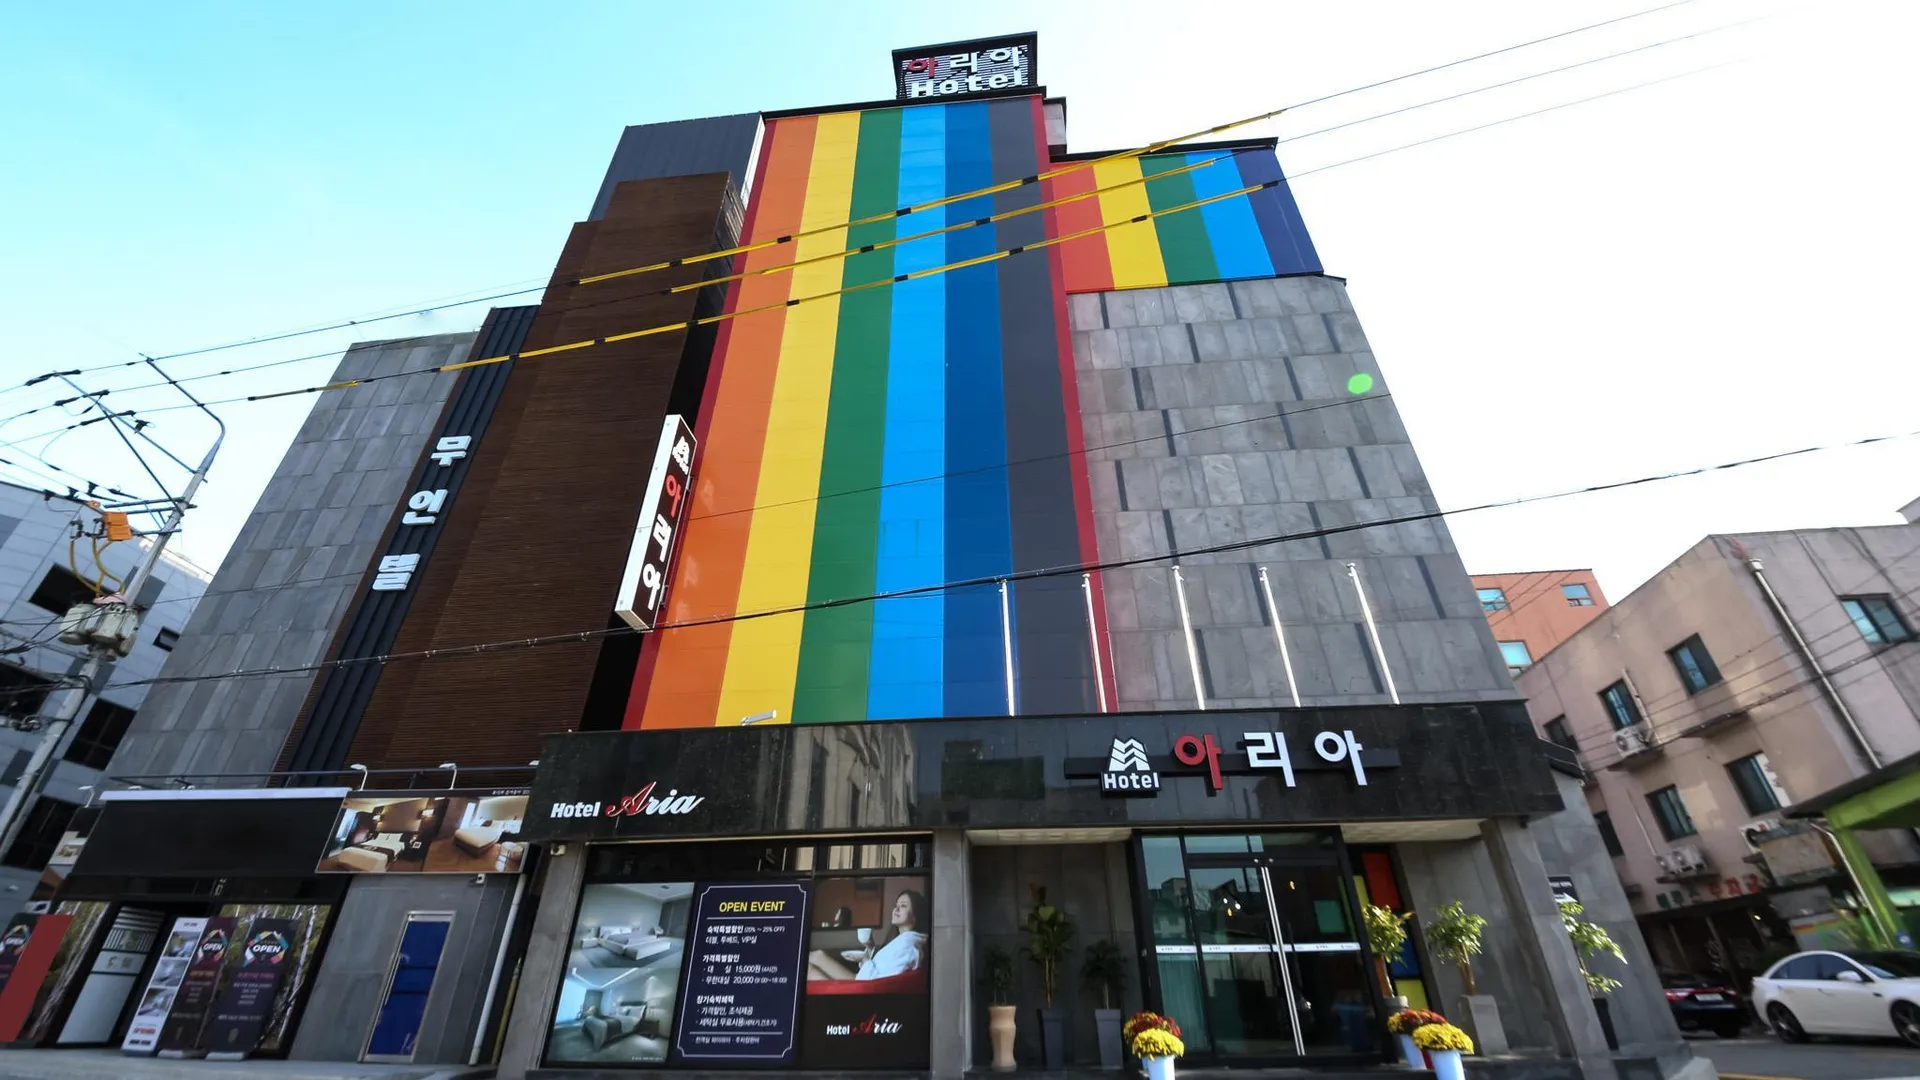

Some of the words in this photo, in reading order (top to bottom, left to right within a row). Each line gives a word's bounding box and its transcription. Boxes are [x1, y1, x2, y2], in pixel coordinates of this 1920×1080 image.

[907, 46, 1023, 78] 아리아
[911, 69, 1024, 98] Hotel
[372, 435, 472, 590] 무인텔
[642, 474, 682, 611] 아리아
[1174, 730, 1368, 790] 아리아
[1103, 771, 1160, 790] Hotel
[550, 801, 601, 818] Hotel
[605, 781, 705, 817] Aria
[719, 901, 748, 912] OPEN
[750, 901, 785, 912] EVENT
[203, 942, 222, 951] OPEN
[252, 944, 281, 953] OPEN
[703, 954, 740, 963] 가격특별할인
[826, 1024, 850, 1035] Hotel
[852, 1010, 903, 1034] Aria
